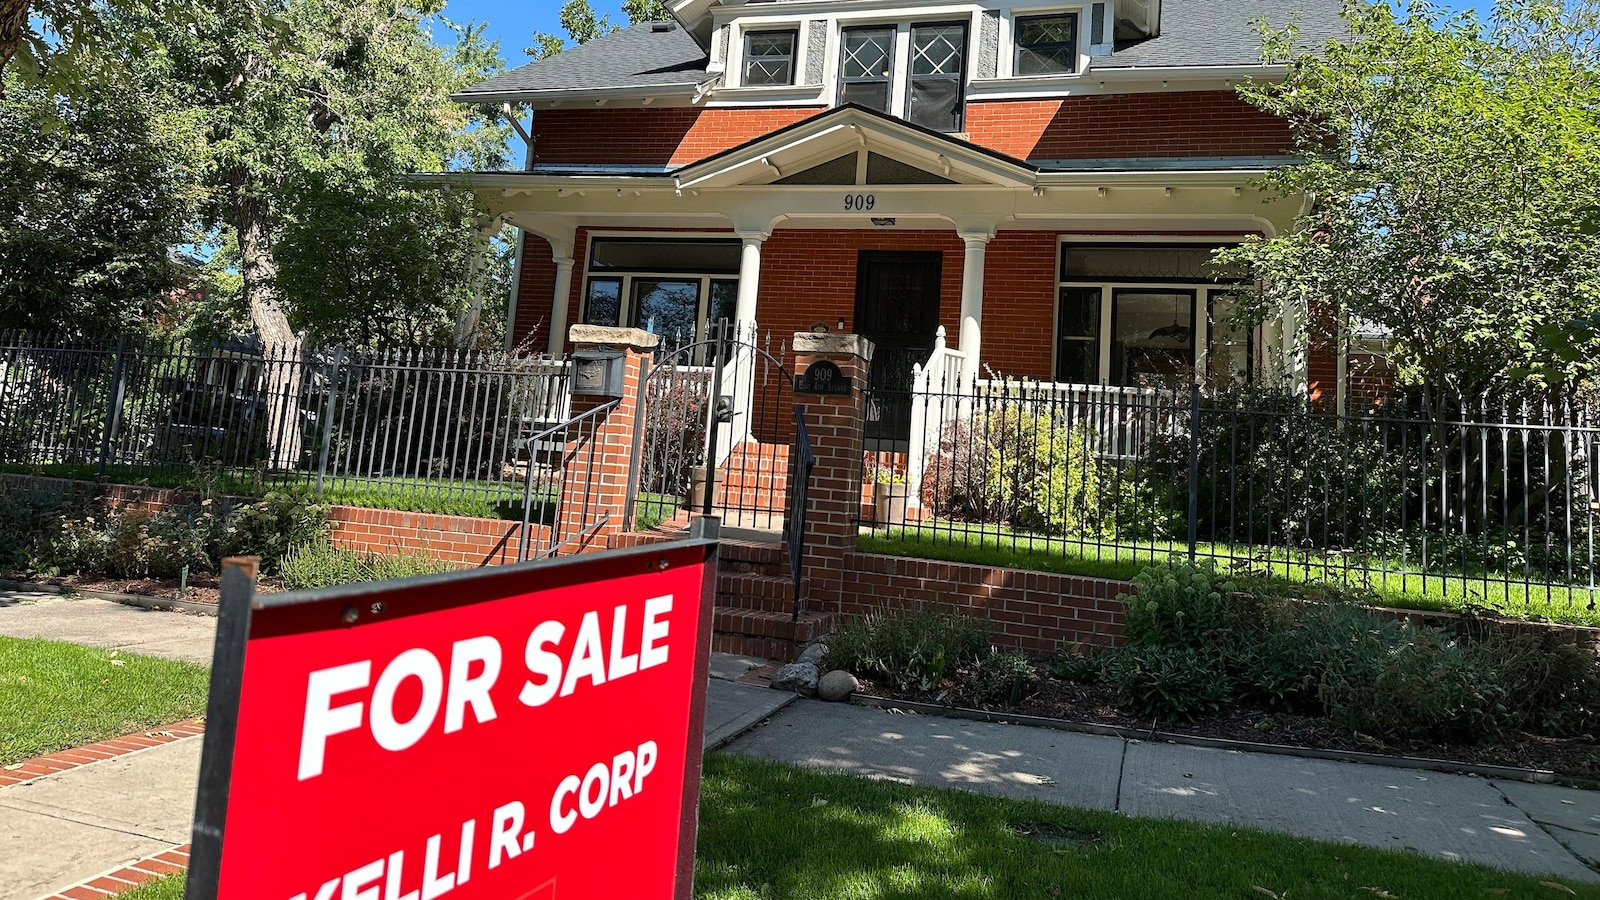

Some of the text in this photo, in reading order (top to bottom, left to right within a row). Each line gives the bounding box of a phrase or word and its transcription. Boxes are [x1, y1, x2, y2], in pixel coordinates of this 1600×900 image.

[844, 194, 875, 211] 909
[814, 368, 833, 381] 909
[297, 594, 674, 781] FOR SALE
[488, 800, 535, 870] R.
[549, 740, 658, 834] CORP
